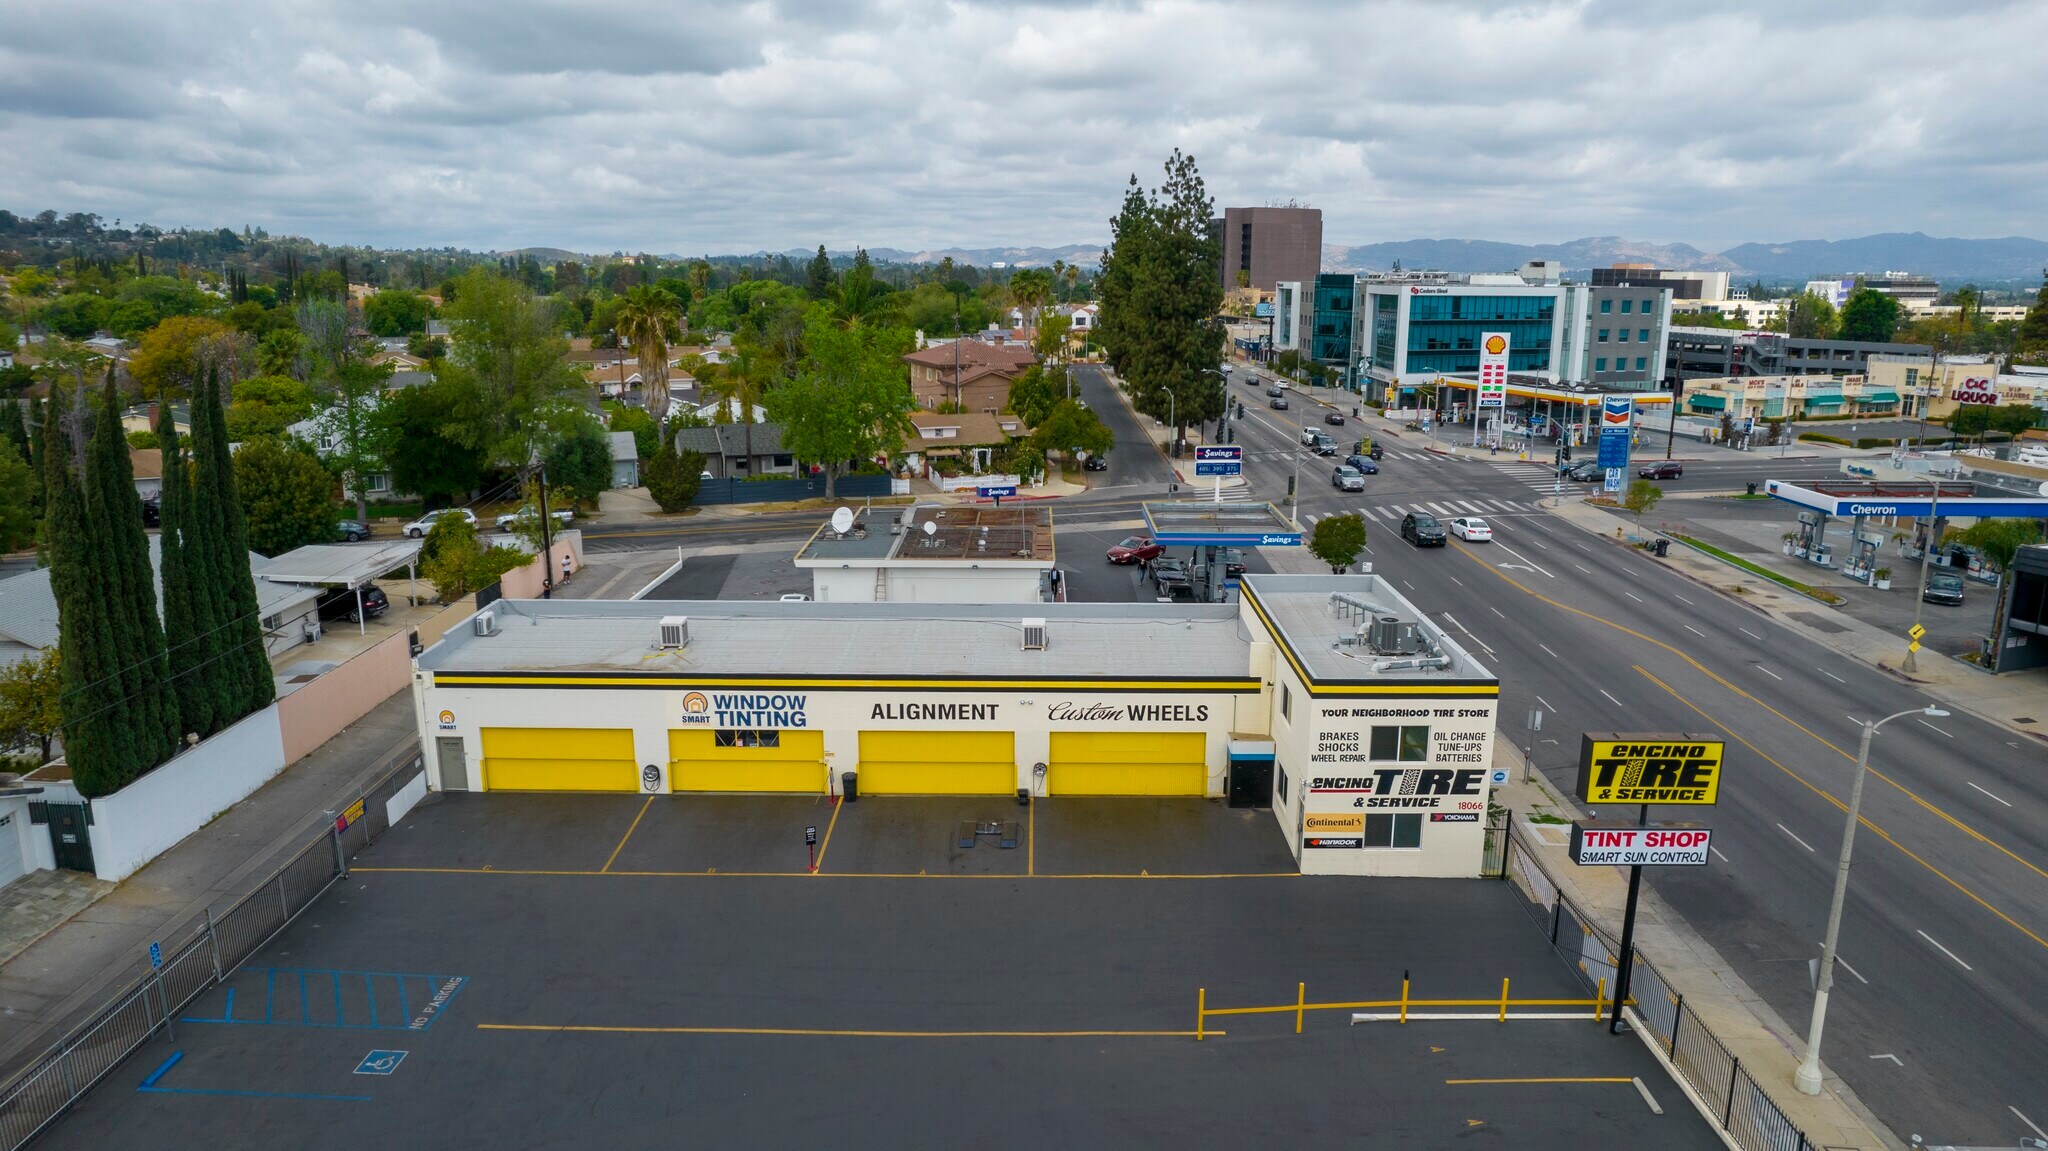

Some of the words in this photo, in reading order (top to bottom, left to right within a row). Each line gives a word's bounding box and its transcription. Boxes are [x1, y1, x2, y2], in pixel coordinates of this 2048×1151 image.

[1965, 378, 1988, 390] C&C
[1951, 390, 1999, 405] LIQUOR
[1850, 504, 1897, 515] Chevron
[712, 694, 807, 710] WINDOW
[870, 703, 1000, 720] ALIGNMENT
[1048, 701, 1124, 722] Custom
[1126, 704, 1209, 722] WHEELS
[1321, 709, 1349, 718] YOUR
[1351, 709, 1430, 718] NEIGHBORHOOD
[1433, 709, 1455, 718] TIRE
[1458, 709, 1490, 718] STORE
[682, 715, 711, 723] SMART
[714, 711, 807, 727] TINTING
[1319, 732, 1360, 741] BRAKES
[1433, 732, 1448, 741] OIL
[1450, 732, 1487, 741] CHANGE
[1318, 743, 1359, 752] SHOCKS
[1438, 743, 1482, 751] TUNE-UPS
[1311, 754, 1337, 762] WHEEL
[1339, 754, 1366, 763] REPAIR
[1435, 754, 1482, 763] BATTERIES
[1594, 759, 1718, 788] TIRE
[1373, 769, 1487, 795] TIRE
[1598, 789, 1611, 800] &
[1616, 789, 1707, 801] SERVICE
[1353, 797, 1364, 807] &
[1367, 797, 1440, 807] SERVICE
[1458, 802, 1483, 810] 18066
[1306, 817, 1354, 828] Continental
[1584, 832, 1638, 847] TINT
[1645, 832, 1708, 848] SHOP
[1580, 852, 1621, 863] SMART
[1623, 852, 1648, 863] SUN
[1650, 852, 1705, 863] CONTROL
[409, 1017, 428, 1029] NO
[422, 977, 462, 1013] PARKING
